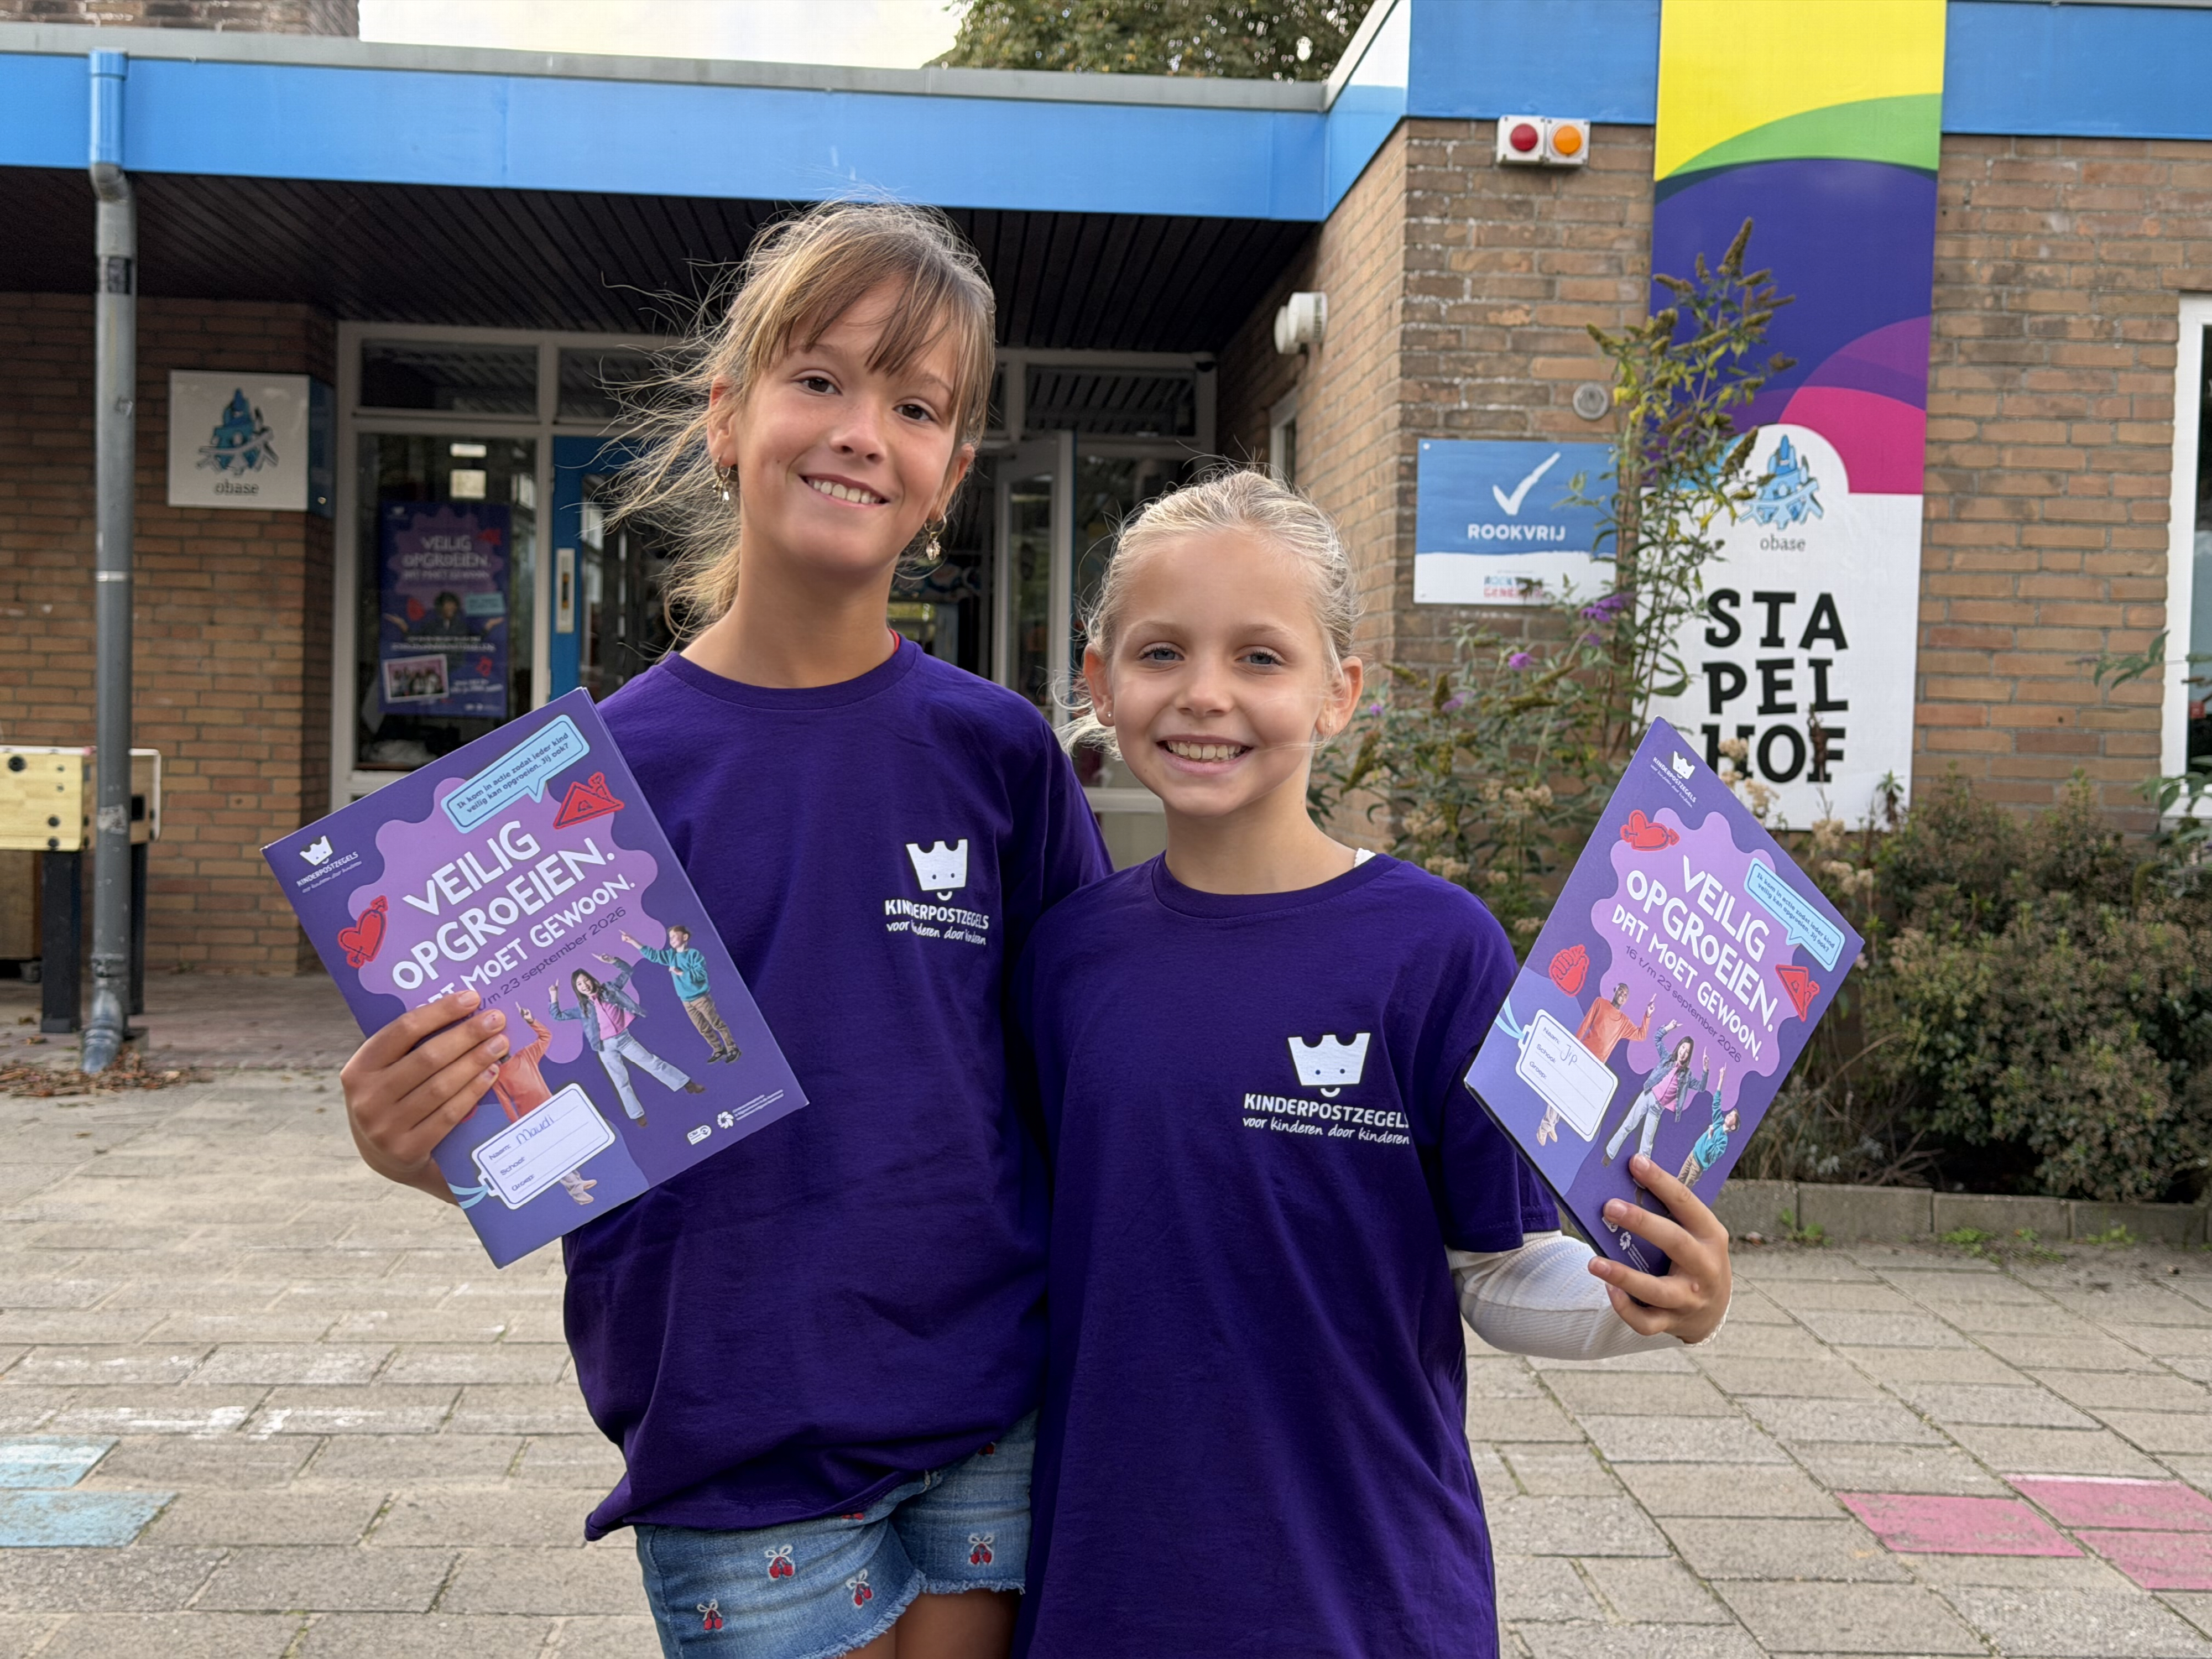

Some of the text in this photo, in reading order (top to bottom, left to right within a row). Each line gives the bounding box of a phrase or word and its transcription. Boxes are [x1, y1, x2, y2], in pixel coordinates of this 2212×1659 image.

[1468, 524, 1566, 541] ROOKVRIJ
[1760, 534, 1806, 551] obase
[1705, 588, 1849, 651] STA
[1702, 658, 1849, 716] PEL
[466, 790, 484, 804] kom
[483, 782, 492, 792] in
[493, 771, 511, 785] actie
[512, 757, 532, 774] zodat
[532, 744, 551, 760] ieder
[552, 733, 568, 747] kind
[467, 742, 569, 813] veilig kan opgroeien. Jij ook?
[1653, 757, 1697, 803] KINDERPOSTZEGELS
[1700, 724, 1846, 783] HOF
[402, 820, 541, 915] VEILIG
[392, 837, 615, 989] OPGROEIEN.
[460, 873, 635, 992] MOET GEWOON.
[886, 921, 910, 931] voor
[943, 926, 964, 941] door
[1683, 854, 1770, 962] VEILIG
[1757, 872, 1835, 949] Ik kom in actie zodat ieder kind
[1758, 883, 1772, 900] veilig
[1773, 896, 1783, 909] kan
[1783, 907, 1809, 934] opgroeien.
[1817, 939, 1829, 952] ook?
[500, 977, 520, 995] 23
[521, 933, 588, 982] september
[589, 906, 627, 936] 2026
[1611, 904, 1762, 1061] DAT MOET GEWOON.
[1626, 870, 1778, 1032] OPGROEIEN.
[1543, 1027, 1561, 1045] Naam:
[1626, 945, 1742, 1063] 16 t/m 23 september 2026
[1560, 1044, 1578, 1066] Jip
[1243, 1117, 1410, 1145] voor kinderen door kinderen
